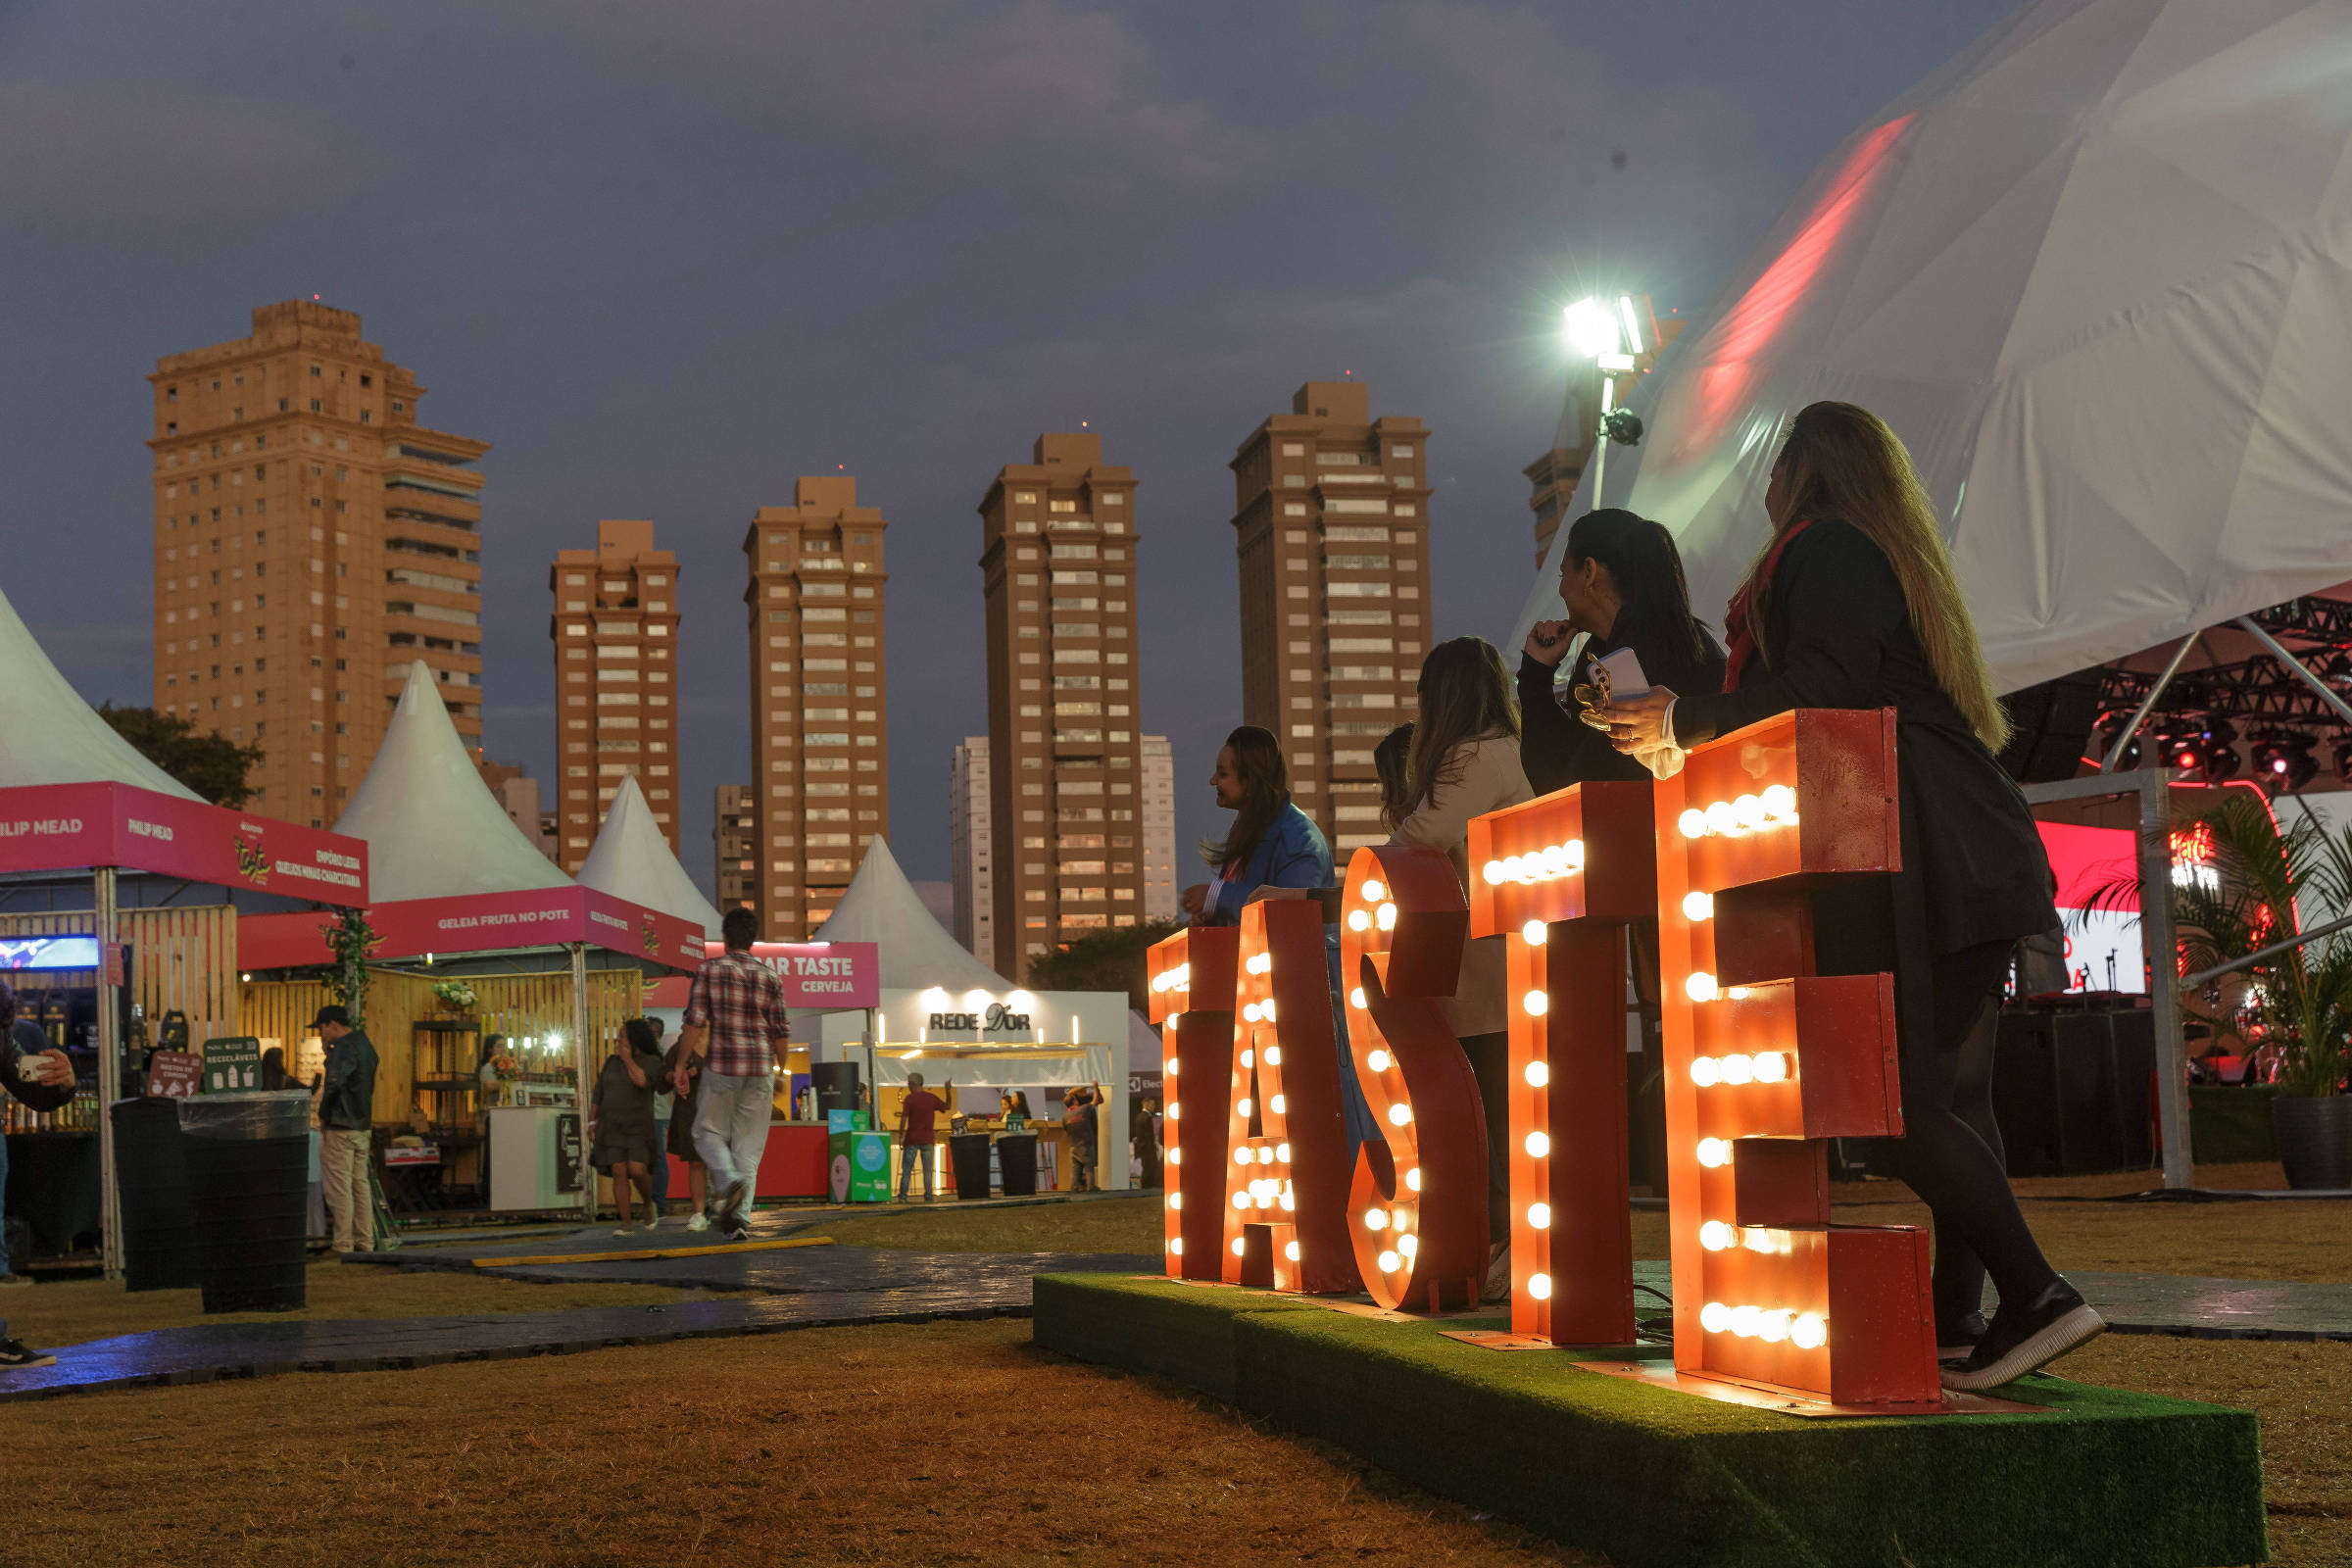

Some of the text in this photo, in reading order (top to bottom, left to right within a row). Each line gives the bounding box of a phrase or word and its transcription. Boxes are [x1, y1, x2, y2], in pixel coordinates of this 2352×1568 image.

[33, 818, 83, 835] MEAD
[152, 823, 173, 842] MEAD
[438, 908, 570, 929] GELEIA FRUTA NO POTE
[754, 956, 854, 976] AR TASTE
[801, 981, 855, 993] CERVEJA
[930, 1012, 979, 1030] REDE
[1147, 708, 1940, 1403] TASTE
